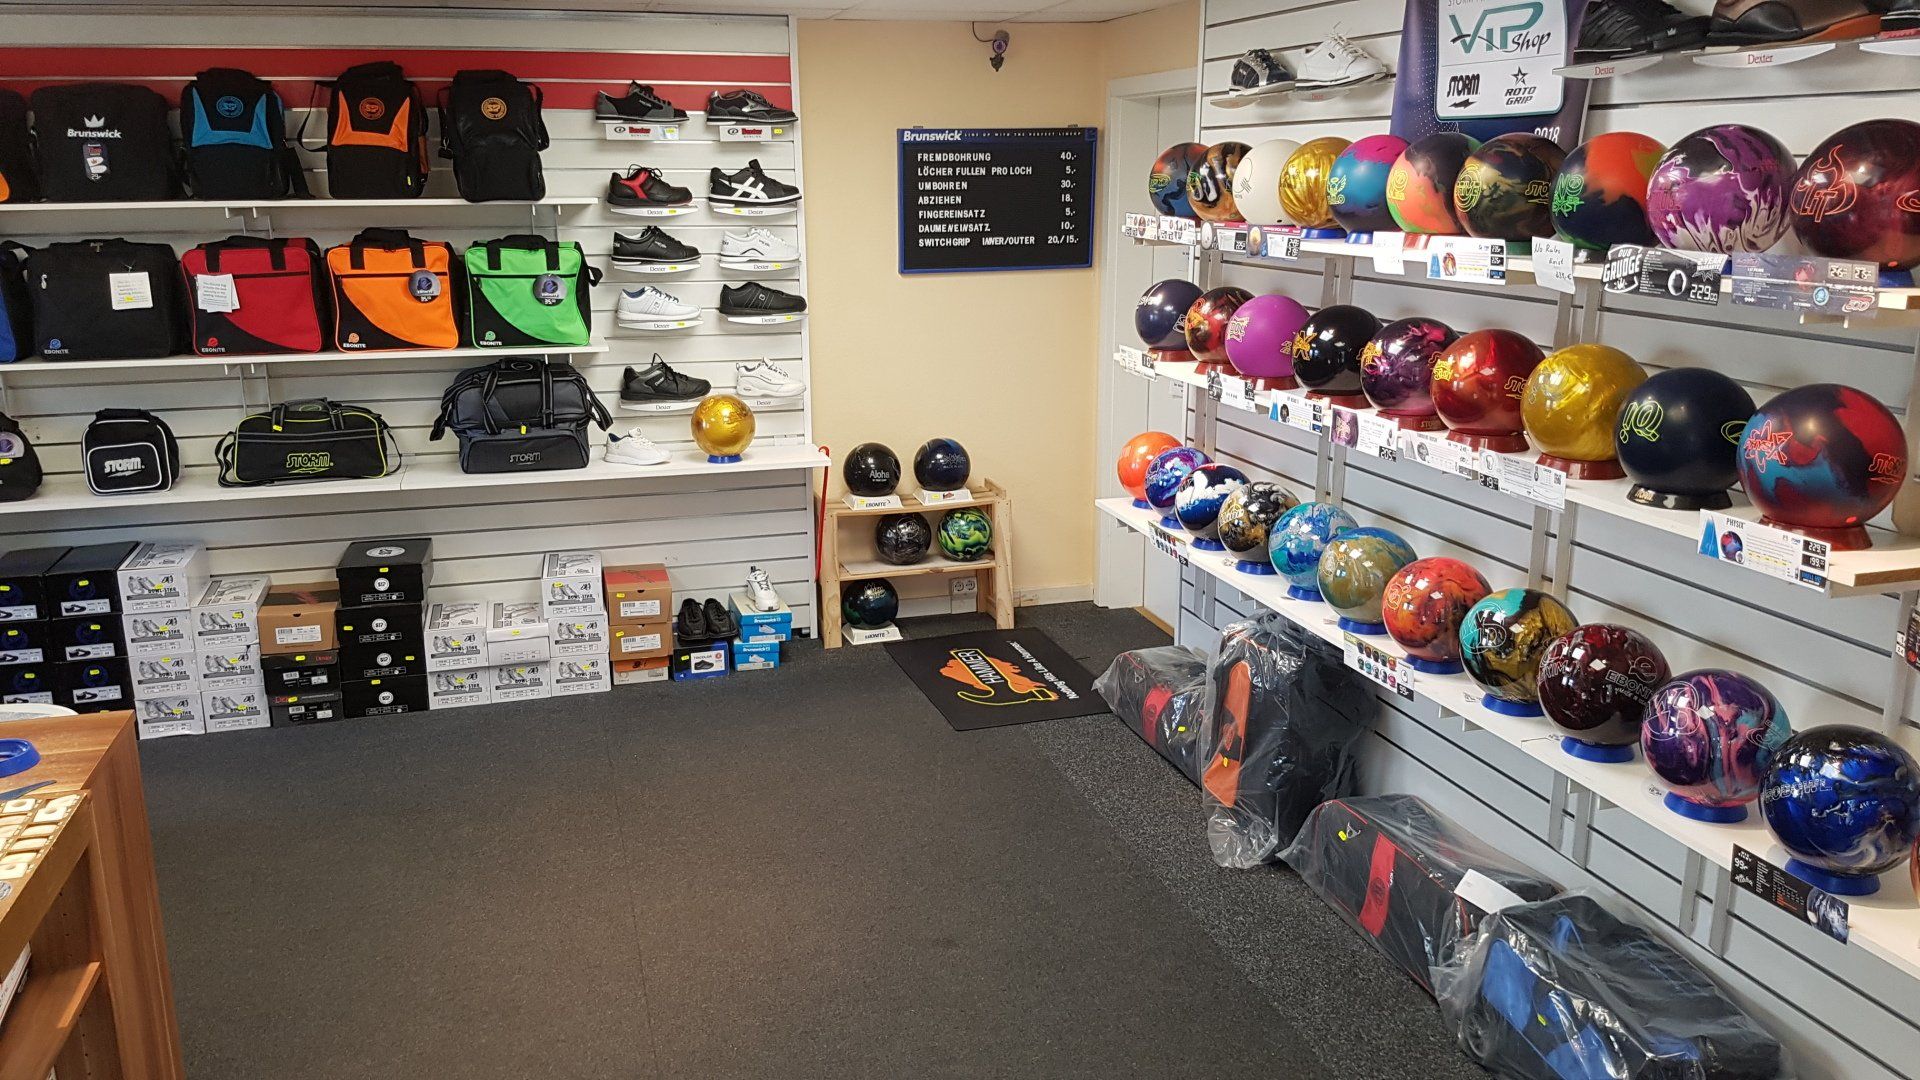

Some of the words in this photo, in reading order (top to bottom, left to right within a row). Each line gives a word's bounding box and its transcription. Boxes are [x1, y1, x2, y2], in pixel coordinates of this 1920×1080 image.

[1449, 2, 1543, 54] VIP
[1512, 31, 1551, 54] Shop
[1748, 54, 1774, 64] Dexter
[1594, 66, 1615, 75] Dexter
[1446, 73, 1480, 97] STORM
[1505, 86, 1537, 97] ROTO
[1506, 95, 1533, 106] GRIP
[67, 128, 122, 139] Brunswick
[904, 130, 962, 141] Brunswick
[917, 152, 991, 162] FREMDBOHRUNG
[917, 165, 953, 176] LÖCHER
[955, 167, 986, 176] FULLEN
[991, 166, 1008, 176] PRO
[1009, 166, 1032, 175] LOCH
[918, 181, 968, 190] UMBOHREN
[1524, 180, 1552, 198] STO
[917, 195, 962, 205] ABZIEHEN
[918, 209, 986, 219] FINGEREINSATZ
[918, 223, 991, 233] DAUMENEINSATZ
[1602, 254, 1642, 283] GRUDGE
[1504, 376, 1527, 393] STO
[286, 452, 331, 468] STORM
[510, 452, 541, 463] STORM
[104, 457, 141, 473] STORM
[869, 469, 890, 479] Aloha
[1726, 517, 1745, 529] PHYSIX
[958, 650, 1005, 684] HAMMER
[1605, 669, 1653, 700] EBONI
